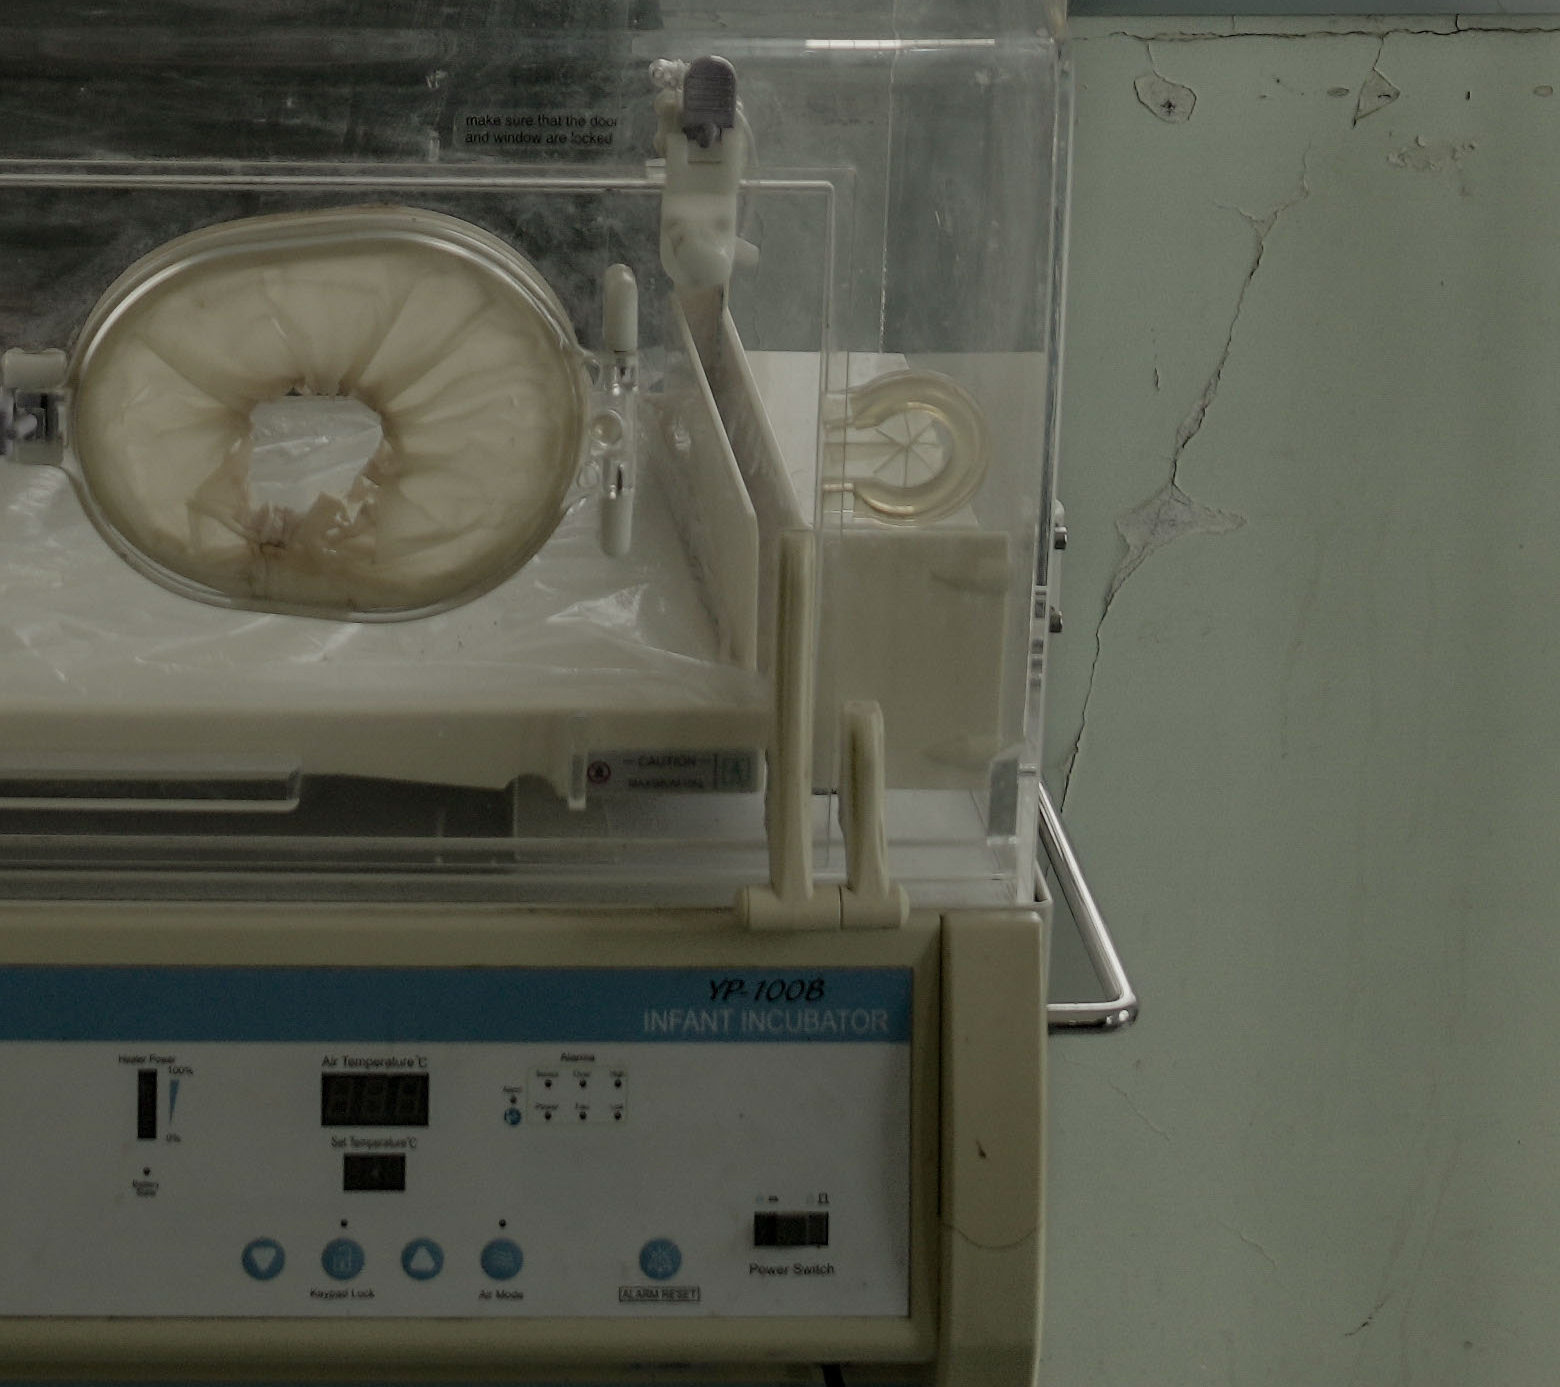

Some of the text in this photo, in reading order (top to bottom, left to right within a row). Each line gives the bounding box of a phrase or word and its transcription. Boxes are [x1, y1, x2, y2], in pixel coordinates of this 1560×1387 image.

[465, 114, 618, 127] make sure that the door
[464, 131, 613, 145] and window are locked
[637, 754, 697, 767] CAUTION
[709, 978, 826, 1003] YP-100B
[643, 1007, 889, 1034] INFANT INCUBATOR
[118, 1054, 176, 1064] Heater Power
[322, 1056, 337, 1067] Air
[168, 1065, 194, 1075] 100%
[166, 1132, 181, 1143] 0%
[331, 1136, 347, 1148] Set
[748, 1262, 835, 1276] Power Switch
[309, 1289, 376, 1300] Keypad Lock
[478, 1289, 524, 1300] Air Mode
[621, 1288, 696, 1300] ALARM RESET
